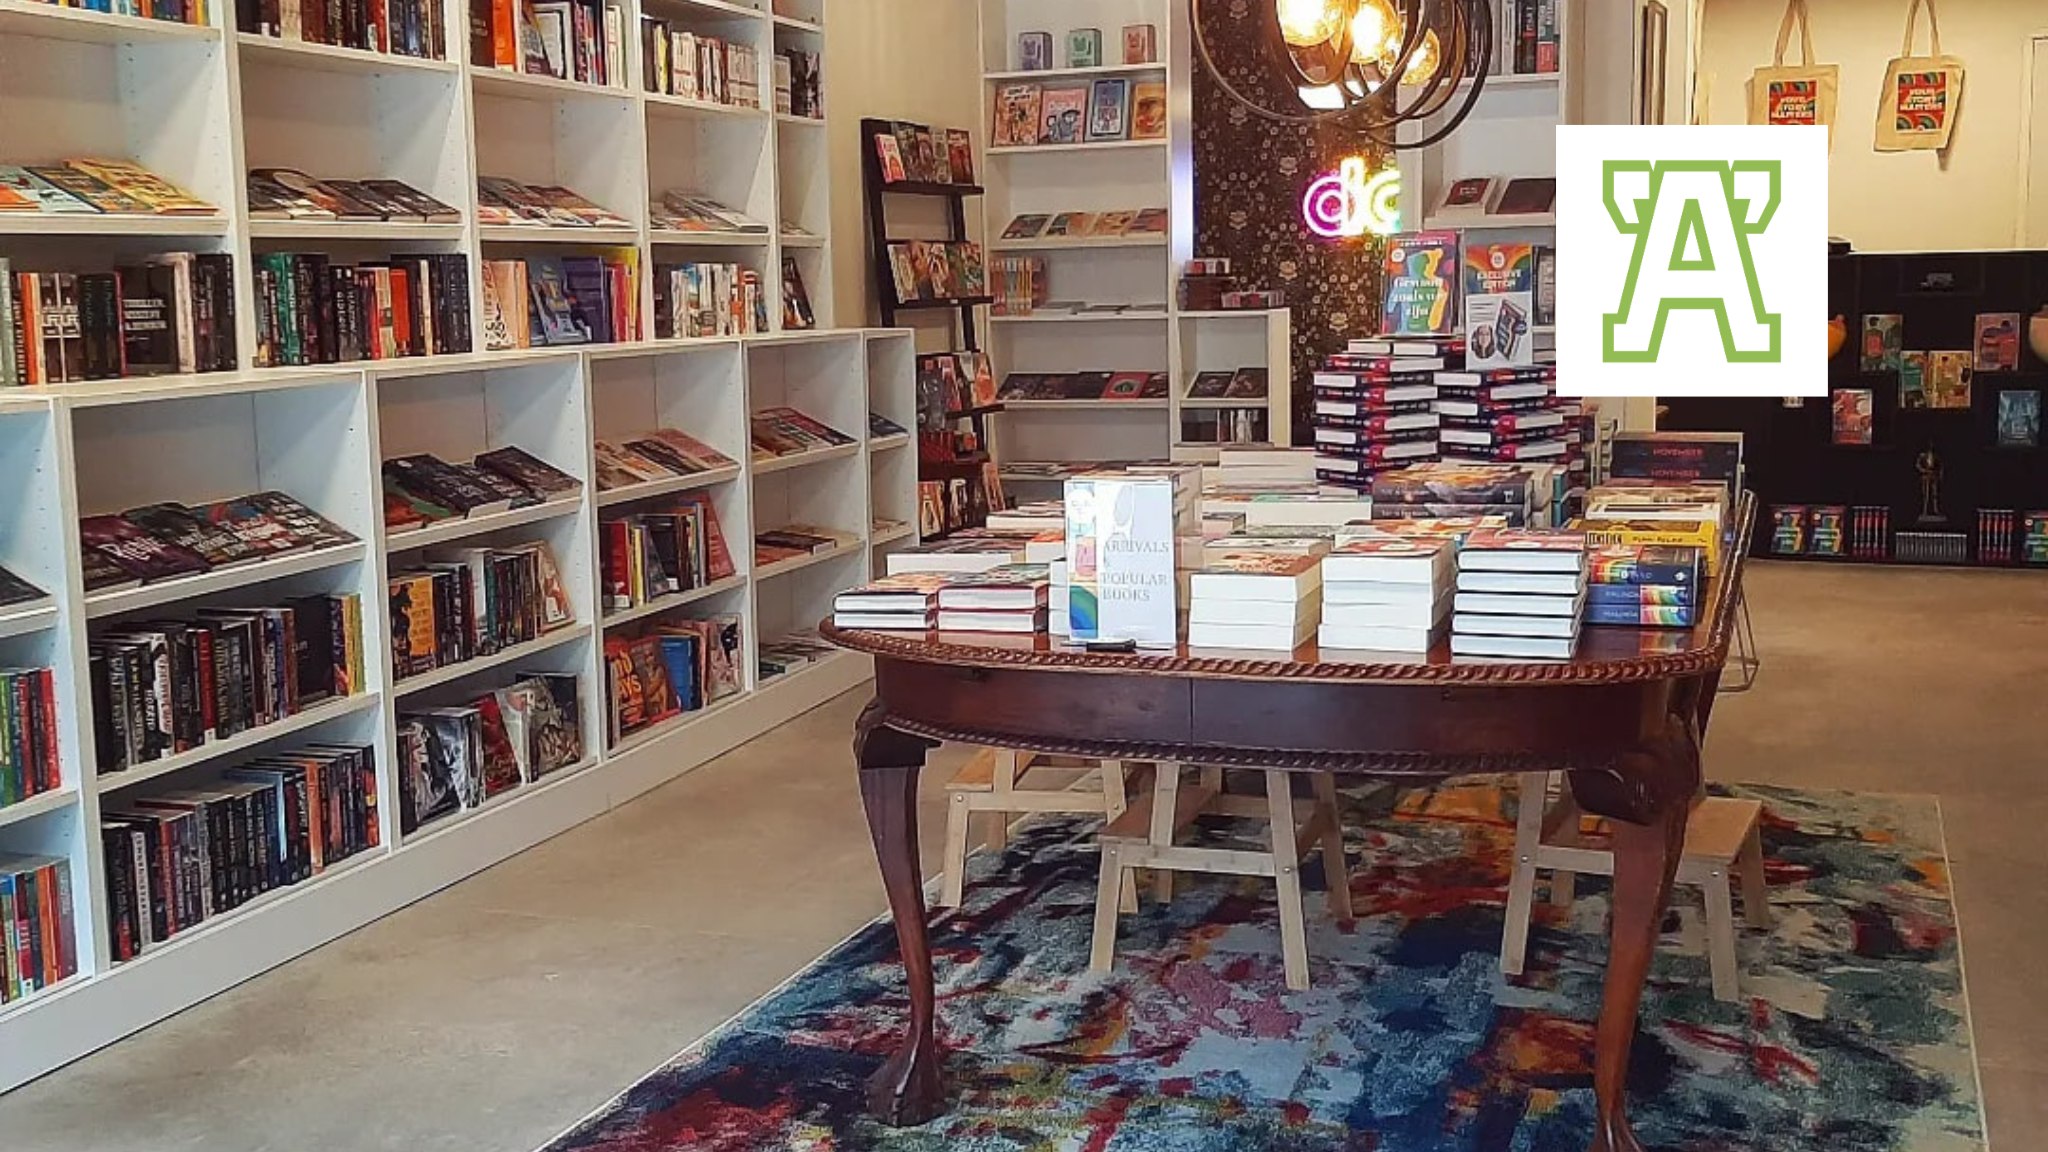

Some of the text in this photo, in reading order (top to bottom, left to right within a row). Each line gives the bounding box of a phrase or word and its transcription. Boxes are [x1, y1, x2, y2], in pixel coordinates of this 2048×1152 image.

[1104, 539, 1169, 553] ARRIVALS
[1103, 572, 1168, 586] POPULAR
[1103, 589, 1150, 601] BOOKS
